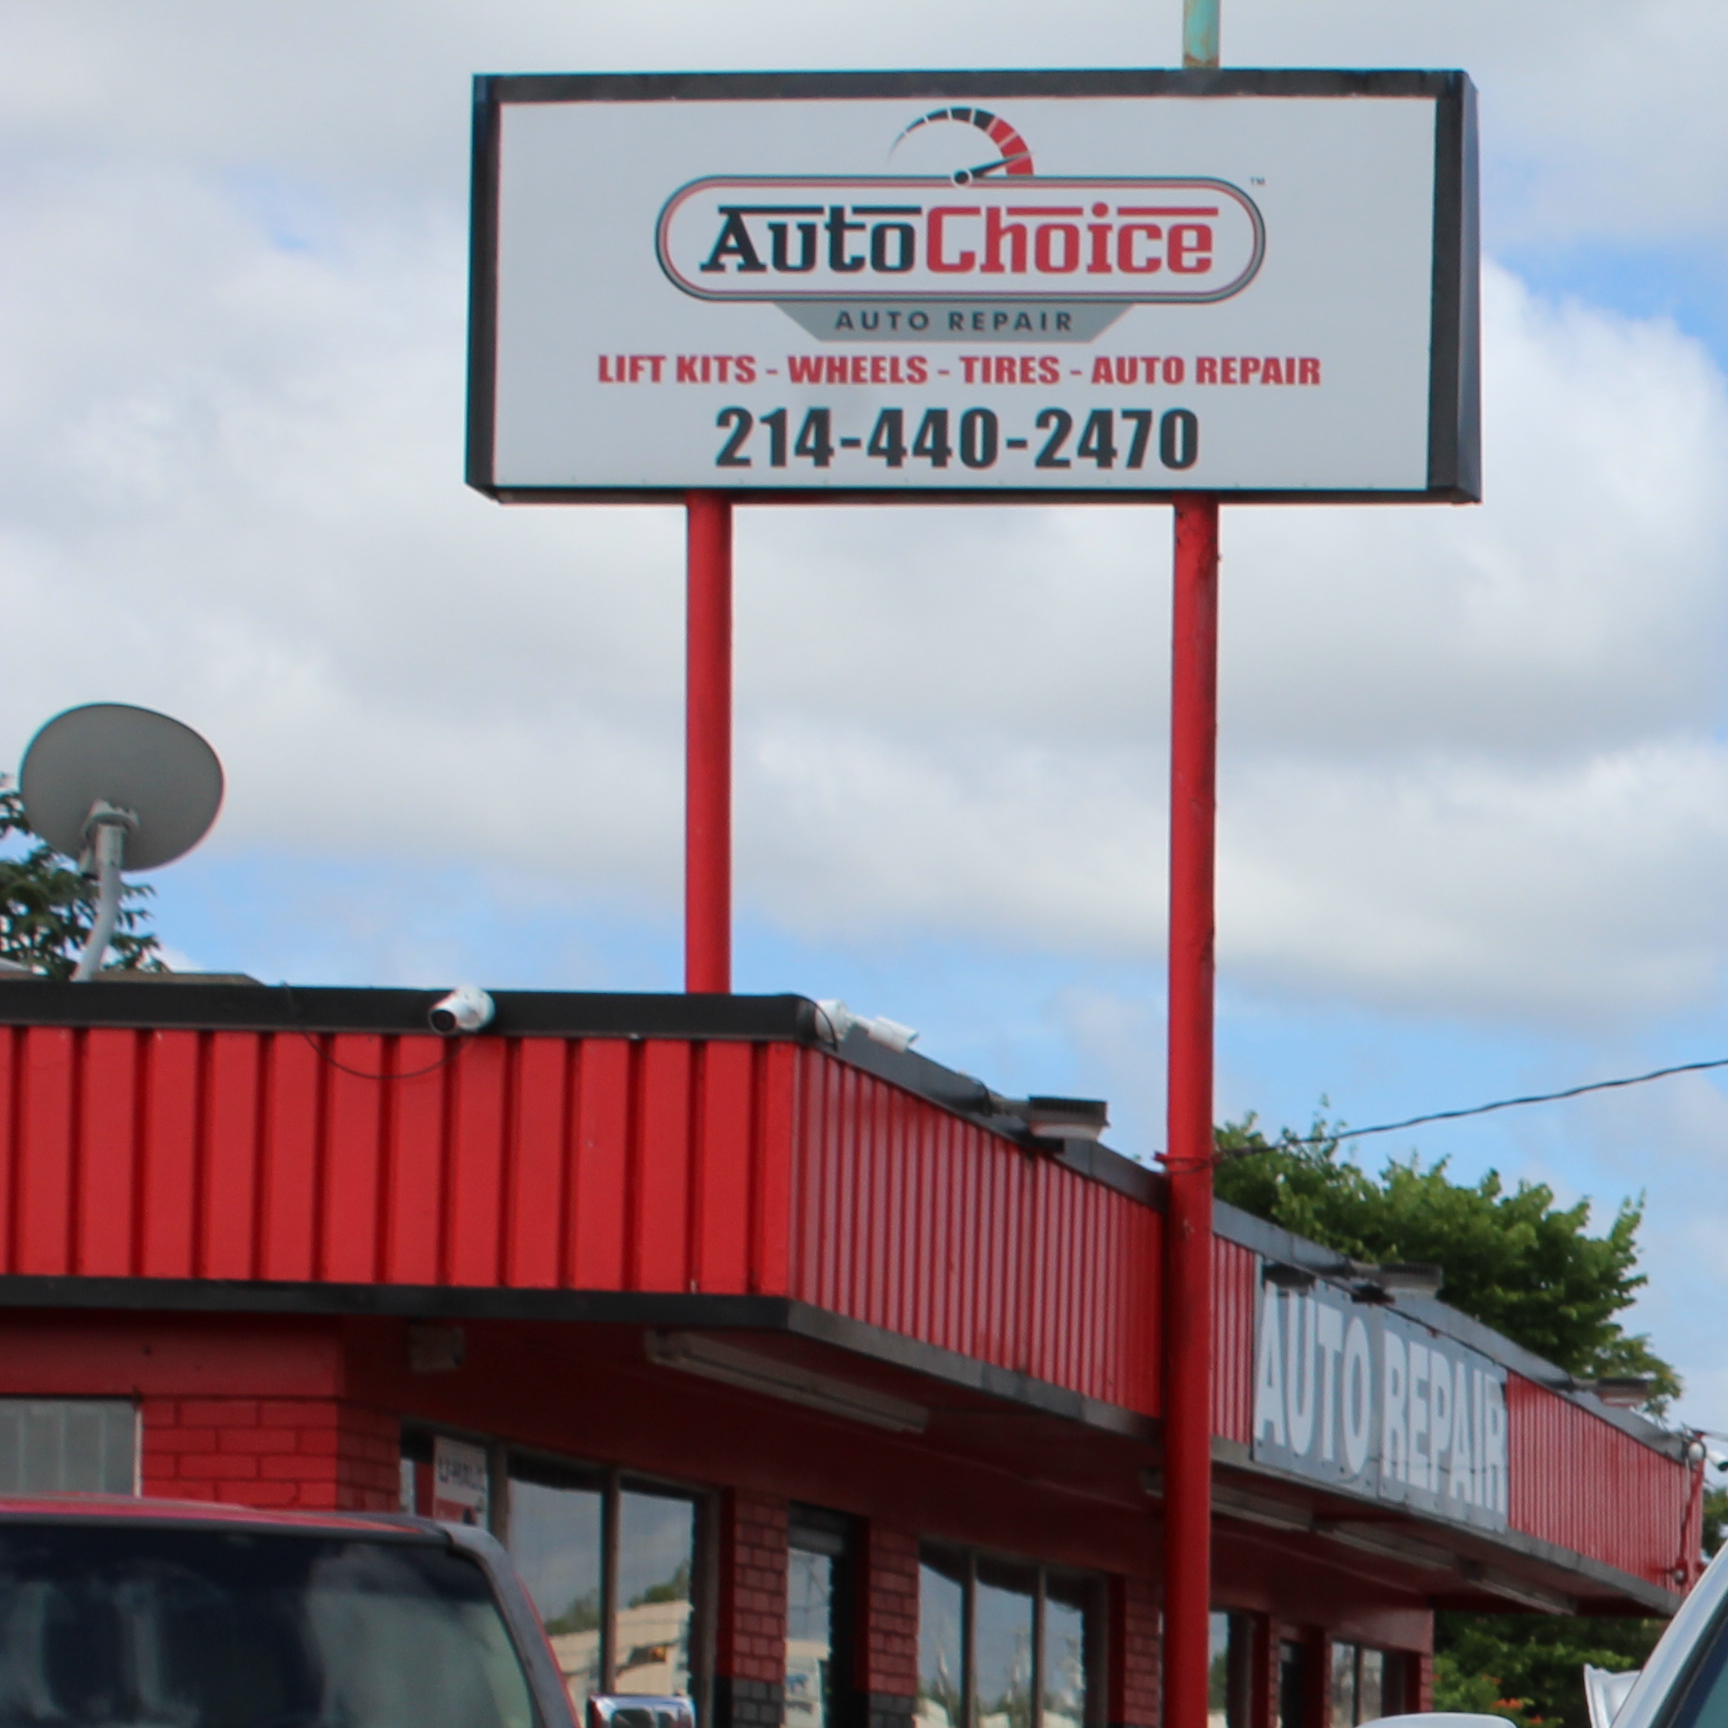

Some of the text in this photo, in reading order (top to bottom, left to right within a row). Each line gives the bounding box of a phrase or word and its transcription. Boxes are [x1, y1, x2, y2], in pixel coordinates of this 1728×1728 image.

[699, 202, 1219, 275] AutoChoice
[835, 310, 1072, 331] AUTO REPAIR
[598, 354, 666, 384] LIFT
[676, 354, 757, 385] KITS
[787, 355, 928, 385] WHEELS
[960, 355, 1060, 385] TIRES
[1091, 355, 1185, 386] AUTO
[1195, 356, 1321, 386] REPAIR
[715, 405, 1199, 471] 214-440-2470
[1254, 1280, 1508, 1516] AUTO REPAIR
